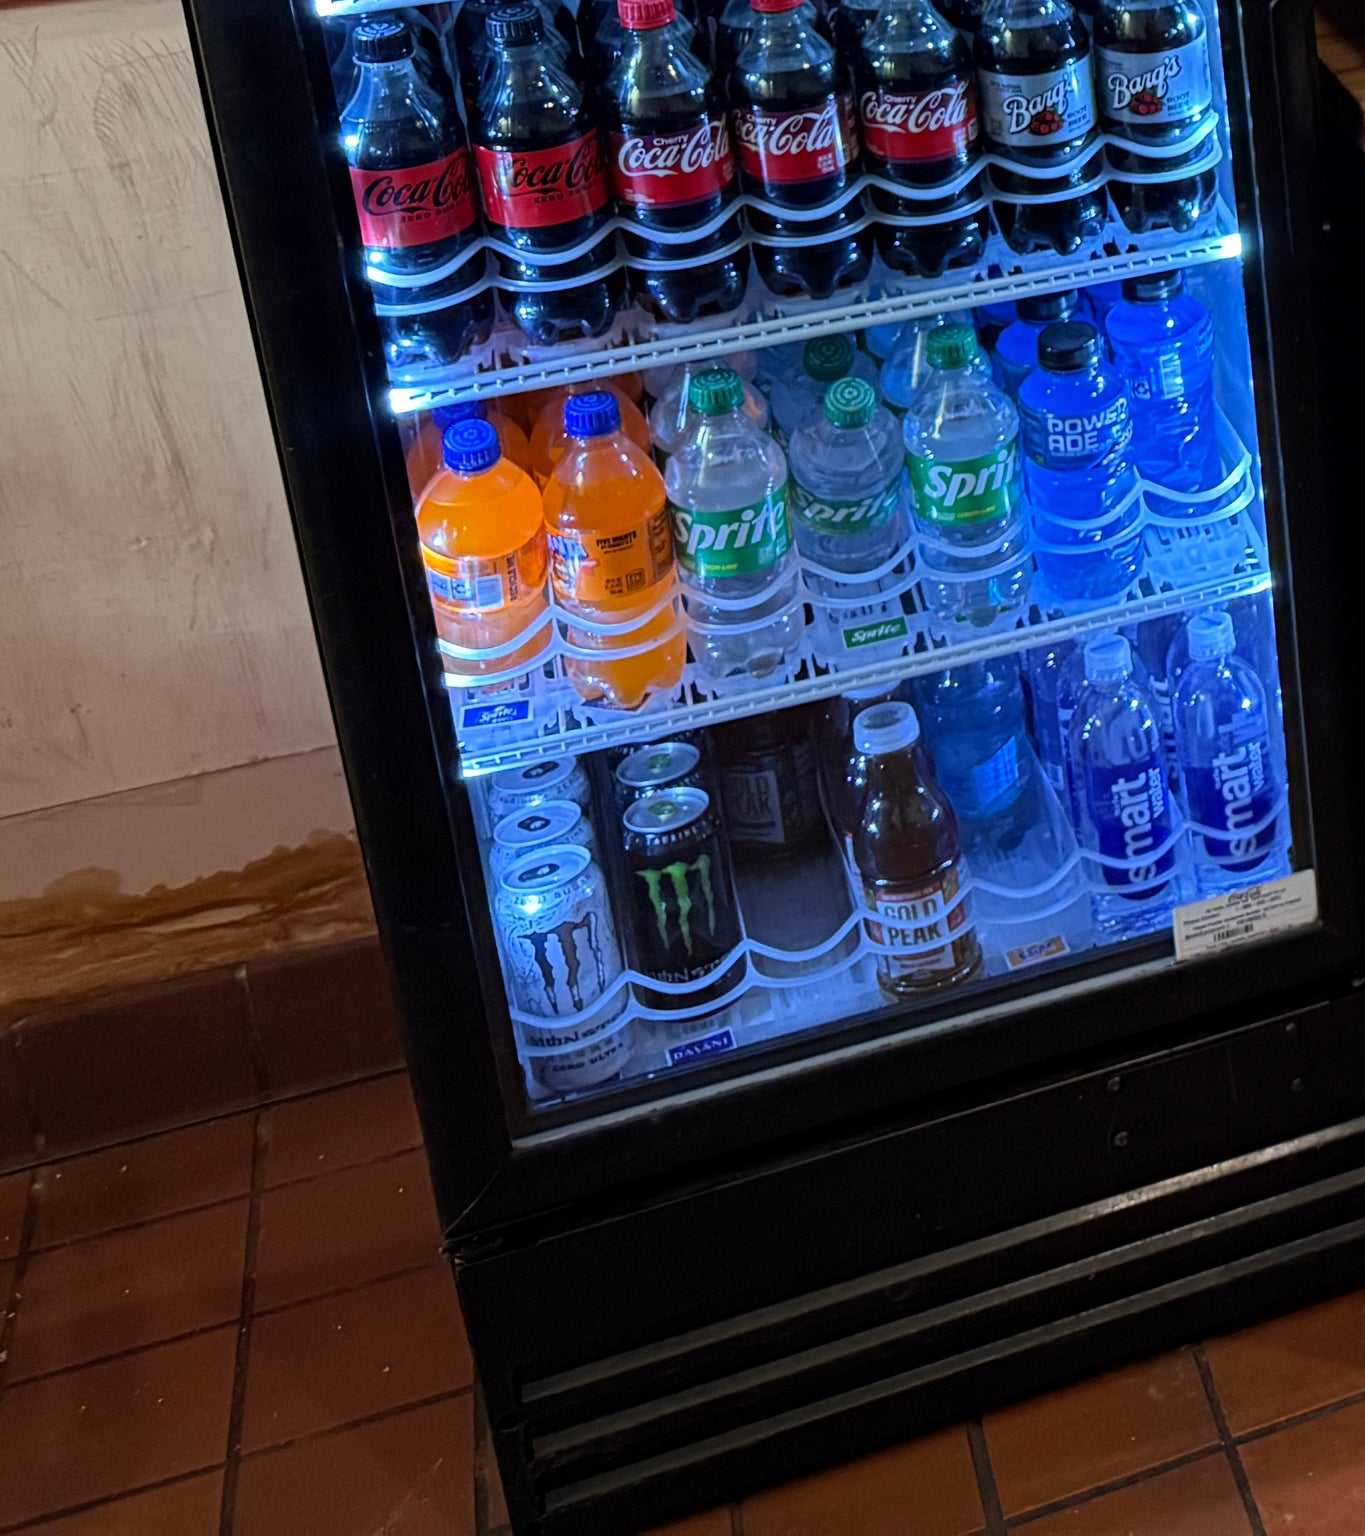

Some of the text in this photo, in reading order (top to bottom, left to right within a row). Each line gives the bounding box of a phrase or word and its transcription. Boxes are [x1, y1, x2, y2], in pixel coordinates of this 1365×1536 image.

[861, 80, 969, 134] Coca-Cola
[884, 93, 917, 104] Cherry
[1108, 54, 1182, 110] Barq's
[653, 134, 689, 146] Cherry
[1049, 431, 1098, 452] ADE
[674, 500, 784, 555] Sprite
[1248, 741, 1265, 792] water
[1148, 767, 1165, 819] water
[1213, 746, 1257, 858] smart
[1111, 772, 1157, 883] smart
[888, 921, 942, 946] PEAK
